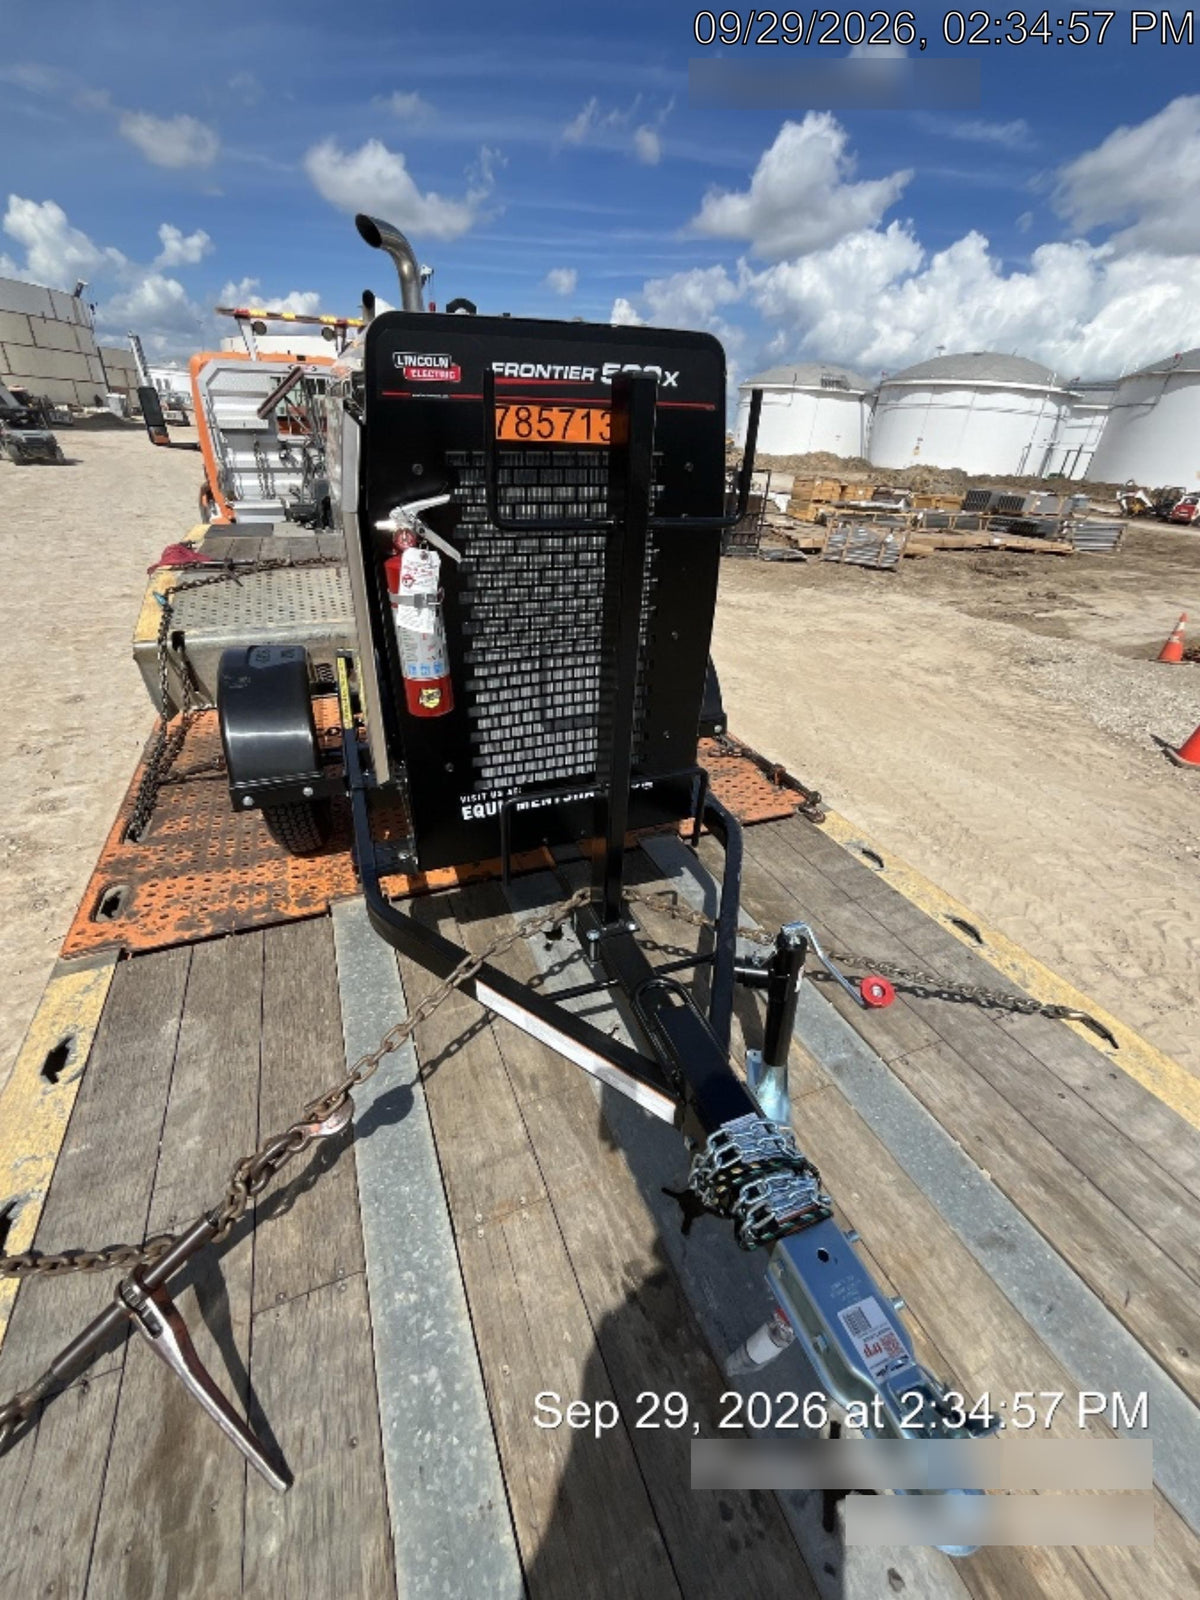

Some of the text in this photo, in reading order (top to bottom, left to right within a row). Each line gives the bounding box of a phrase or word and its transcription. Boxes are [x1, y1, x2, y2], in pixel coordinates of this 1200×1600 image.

[397, 355, 449, 368] LINCOLN
[410, 368, 456, 379] ELECTRIC
[492, 362, 595, 381] FRONTIER
[495, 405, 611, 442] 785713
